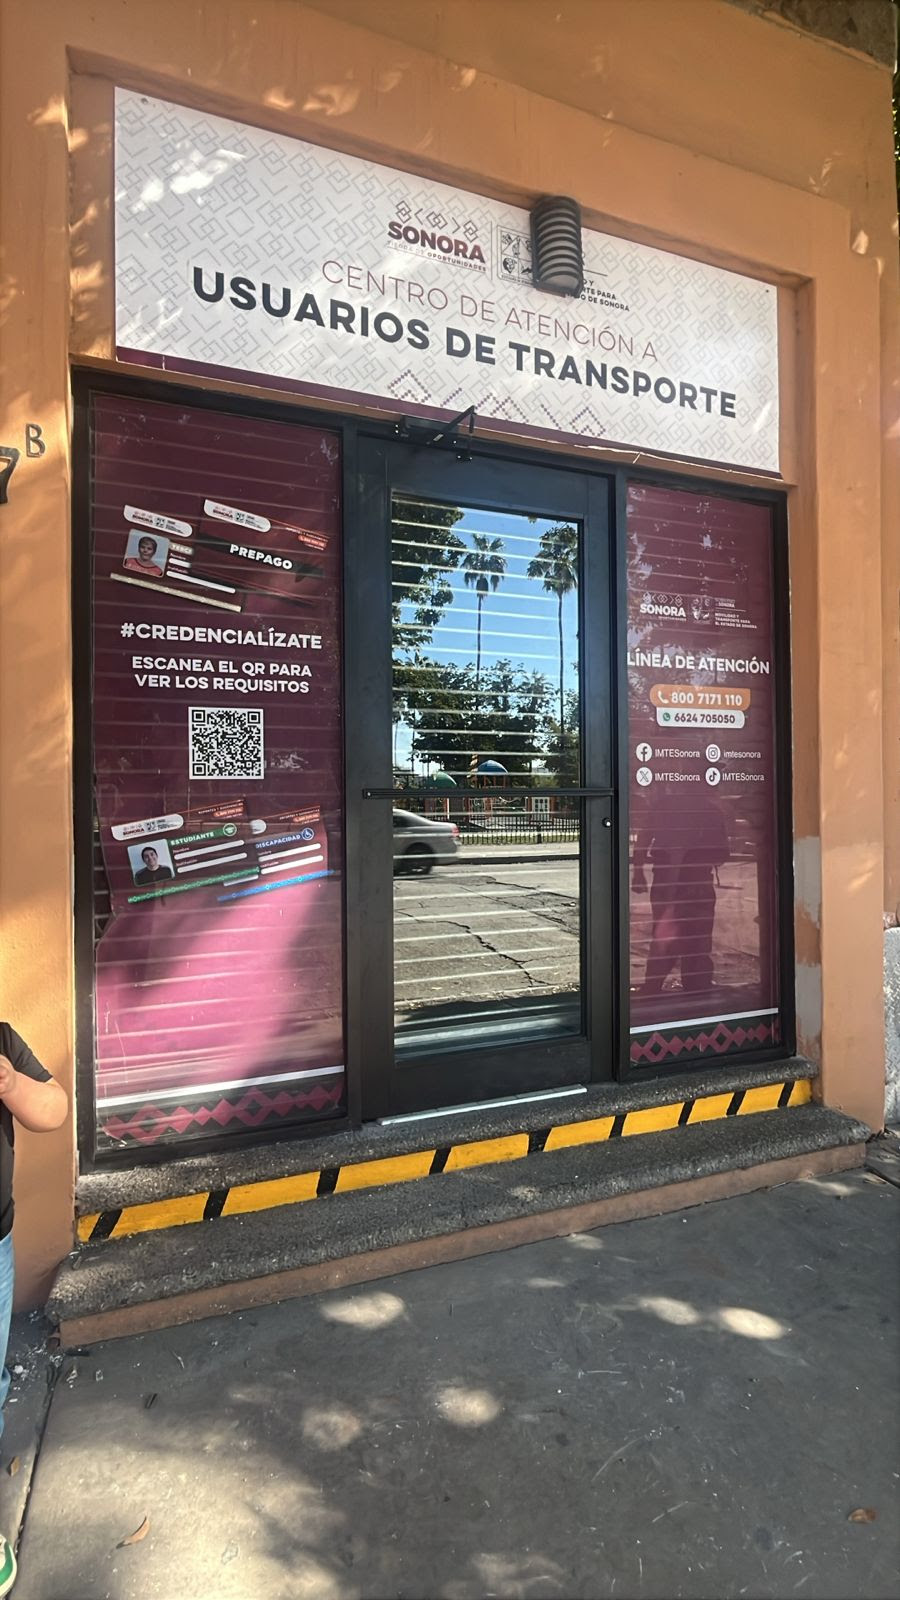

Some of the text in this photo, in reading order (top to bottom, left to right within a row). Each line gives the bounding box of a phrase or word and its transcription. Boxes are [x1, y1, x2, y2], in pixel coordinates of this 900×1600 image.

[387, 221, 485, 264] SONORA
[588, 296, 598, 304] DE
[600, 299, 630, 311] SONORA
[597, 290, 616, 300] PARA
[322, 260, 658, 361] CENTRO DE ATENCIÓN A
[193, 266, 736, 418] USUARIOS DE TRANSPORTE
[25, 423, 46, 458] B
[230, 543, 293, 570] PREPAGO
[639, 603, 687, 617] SONORA
[120, 622, 322, 649] #CREDENCIALÍZATE
[132, 656, 312, 677] ESCANEA EL QR PARA
[627, 647, 770, 674] LÍNEA DE ATENCIÓN
[134, 674, 310, 694] VER LOS REQUISITOS
[671, 692, 743, 706] 800 7171 110
[655, 748, 761, 759] IMTESonora imtesonora
[655, 772, 765, 782] IMTESonora IMTESonora
[170, 831, 215, 846] ESTUDIANTE
[256, 834, 301, 849] DISCAPACIDAD
